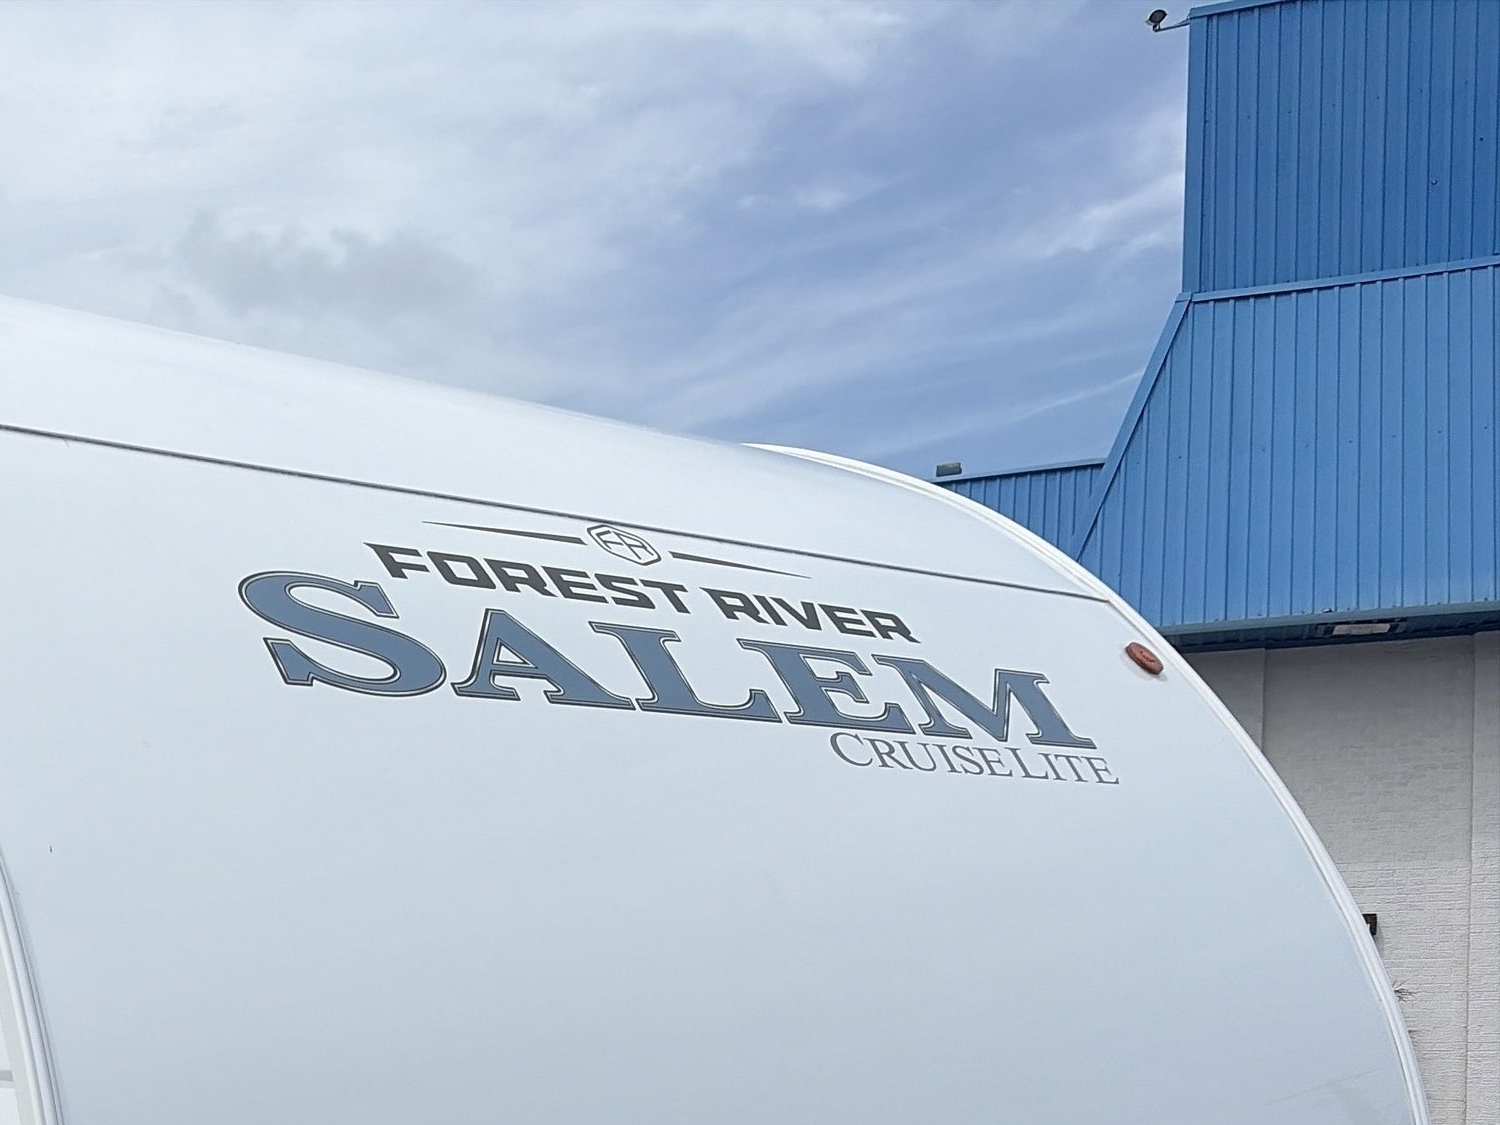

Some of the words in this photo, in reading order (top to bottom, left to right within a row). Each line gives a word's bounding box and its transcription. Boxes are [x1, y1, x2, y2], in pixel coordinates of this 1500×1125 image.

[237, 569, 1098, 750] SALEM
[364, 542, 692, 612] FOREST
[699, 587, 920, 644] RIVER
